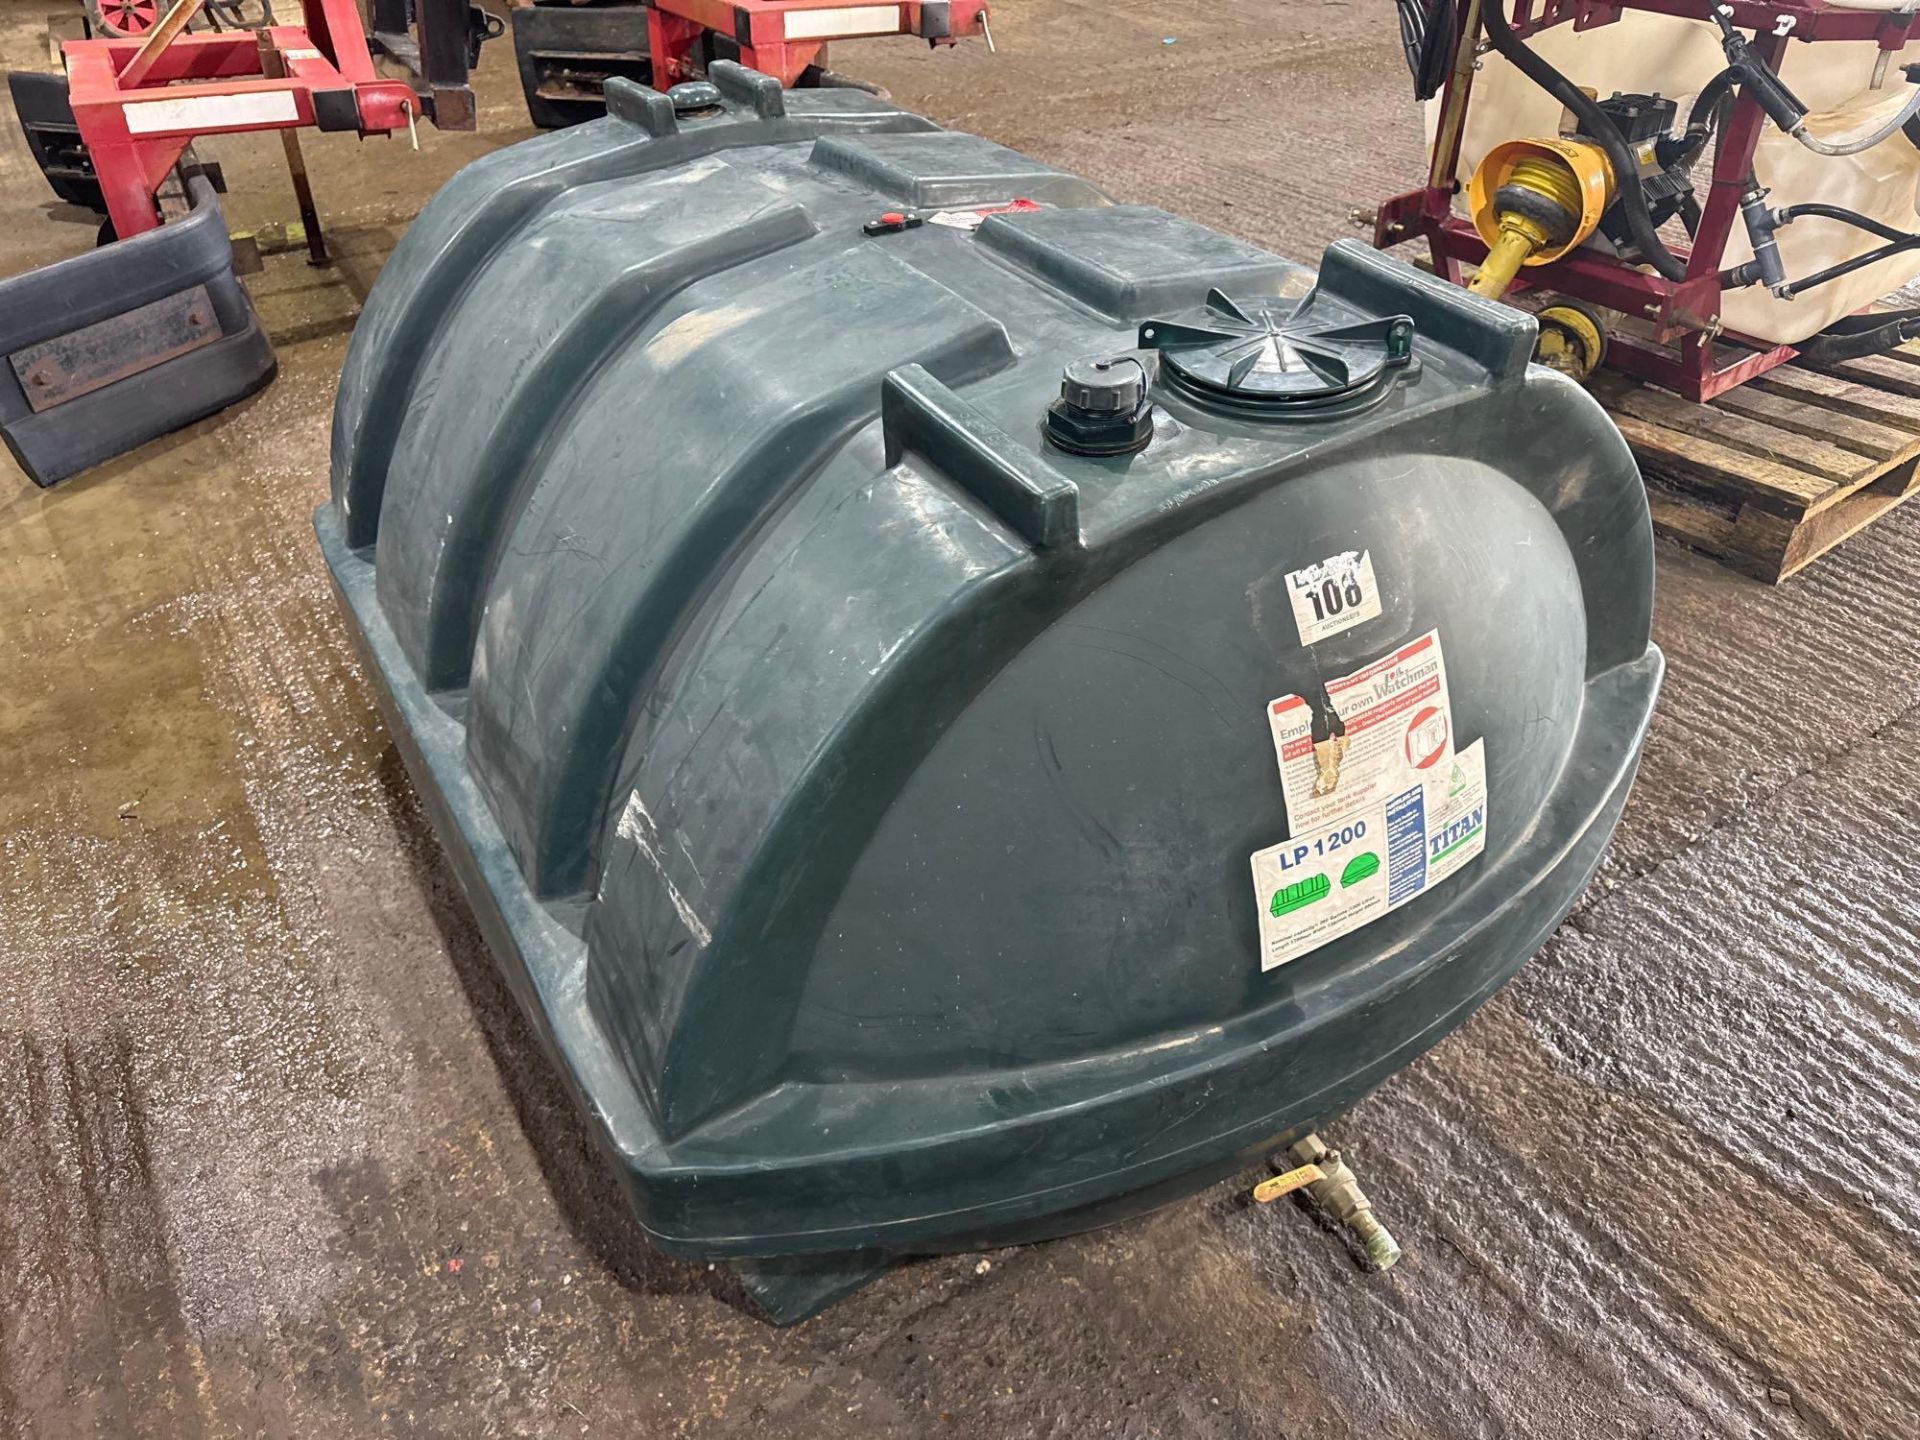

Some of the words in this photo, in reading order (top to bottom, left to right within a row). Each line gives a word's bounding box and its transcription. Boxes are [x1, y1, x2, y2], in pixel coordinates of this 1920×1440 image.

[1306, 569, 1362, 621] 108
[1321, 611, 1361, 631] AUCTIONEERS
[1351, 696, 1373, 711] own
[1373, 661, 1438, 699] Watchman
[1294, 807, 1319, 821] Contact
[1321, 800, 1336, 812] your
[1337, 794, 1351, 804] tank
[1429, 805, 1484, 855] TITAN
[1279, 845, 1309, 871] LP
[1314, 820, 1367, 857] 1200
